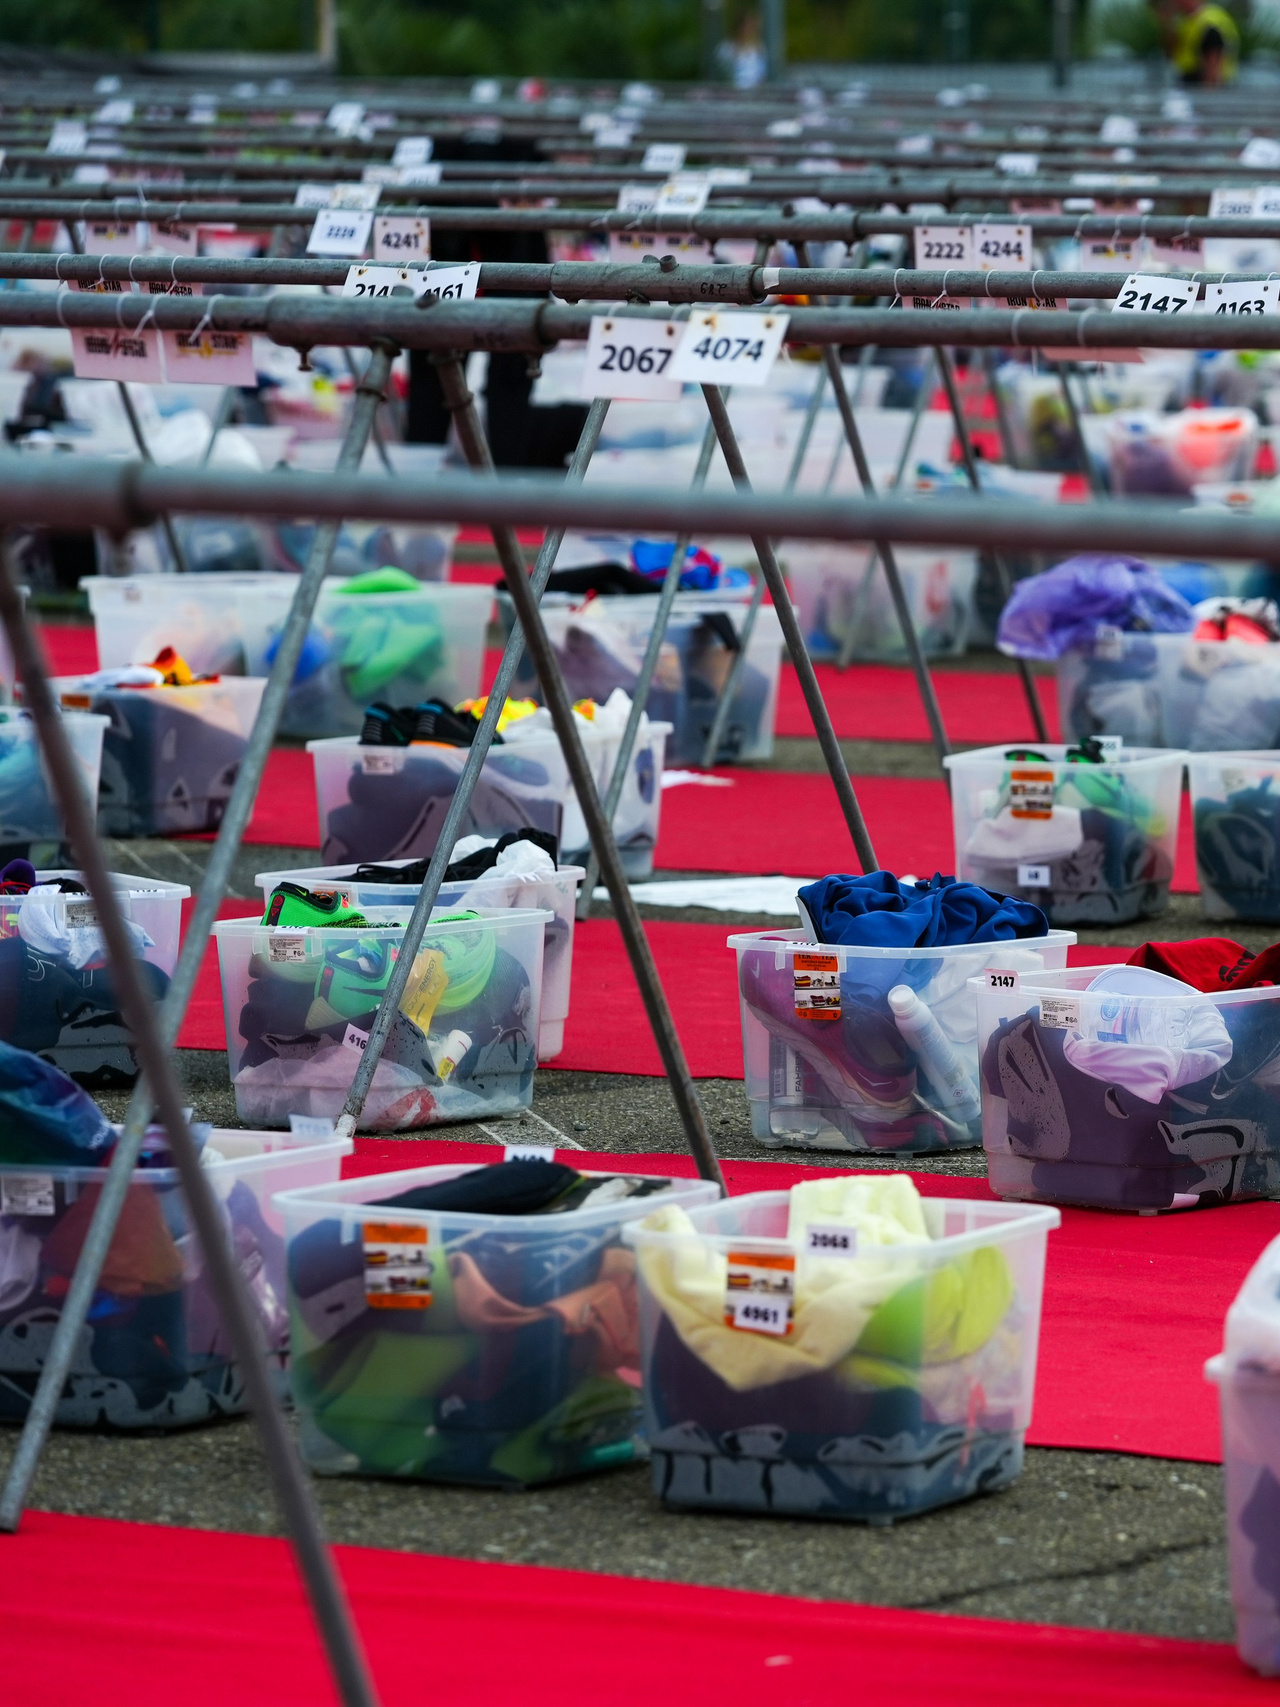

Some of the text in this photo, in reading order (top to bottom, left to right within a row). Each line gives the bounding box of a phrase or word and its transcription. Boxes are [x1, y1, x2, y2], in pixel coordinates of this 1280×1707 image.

[923, 241, 965, 260] 2222
[979, 240, 1024, 258] 4244
[103, 281, 122, 292] STAR
[354, 283, 397, 298] 214
[1118, 289, 1188, 315] 2147
[1214, 299, 1266, 316] 4163
[693, 336, 766, 362] 4074
[598, 344, 673, 375] 2067
[990, 975, 1015, 988] 2147
[348, 1033, 368, 1051] 416
[810, 1232, 849, 1250] 2068
[742, 1304, 779, 1325] 4961
